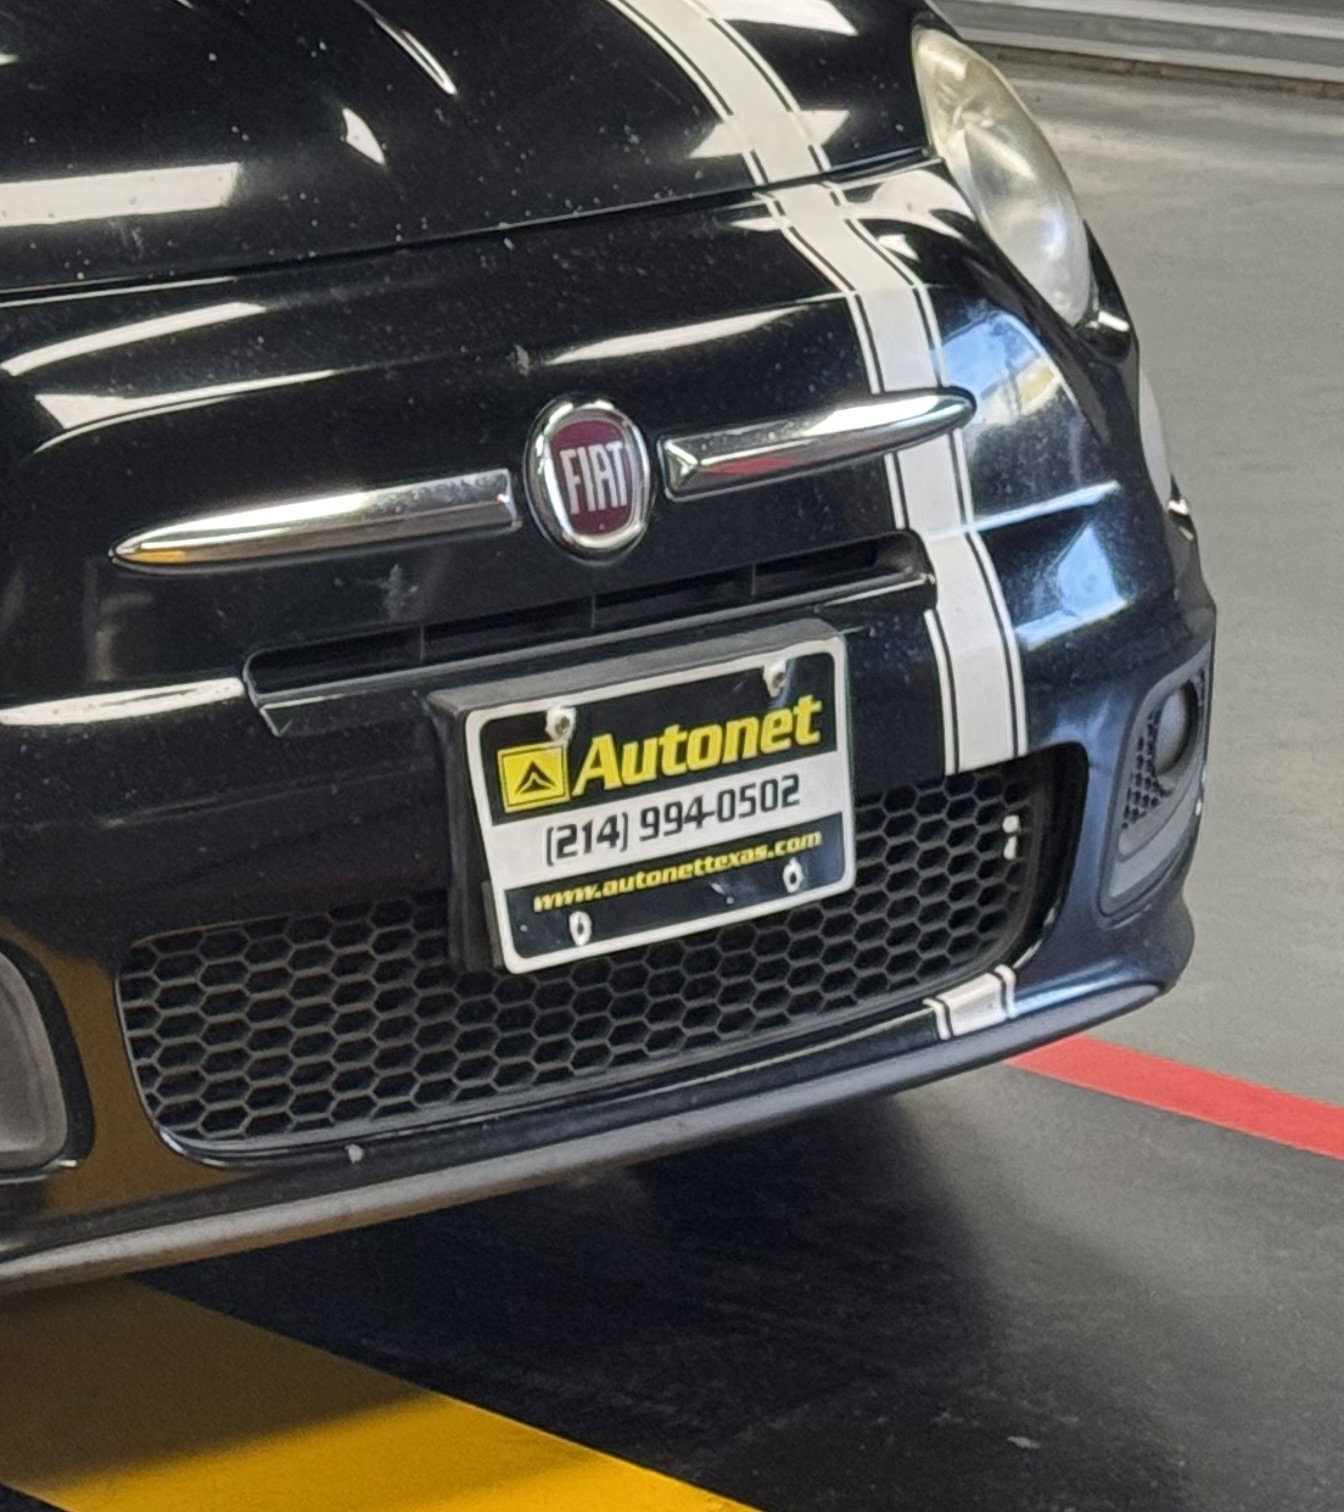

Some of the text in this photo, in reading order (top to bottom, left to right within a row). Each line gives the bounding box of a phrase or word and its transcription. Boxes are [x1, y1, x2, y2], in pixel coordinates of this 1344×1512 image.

[560, 440, 627, 515] FIAT
[572, 695, 822, 796] Autonet
[546, 773, 801, 867] (214) 994-0502
[533, 830, 822, 913] www.autonettexas.com
